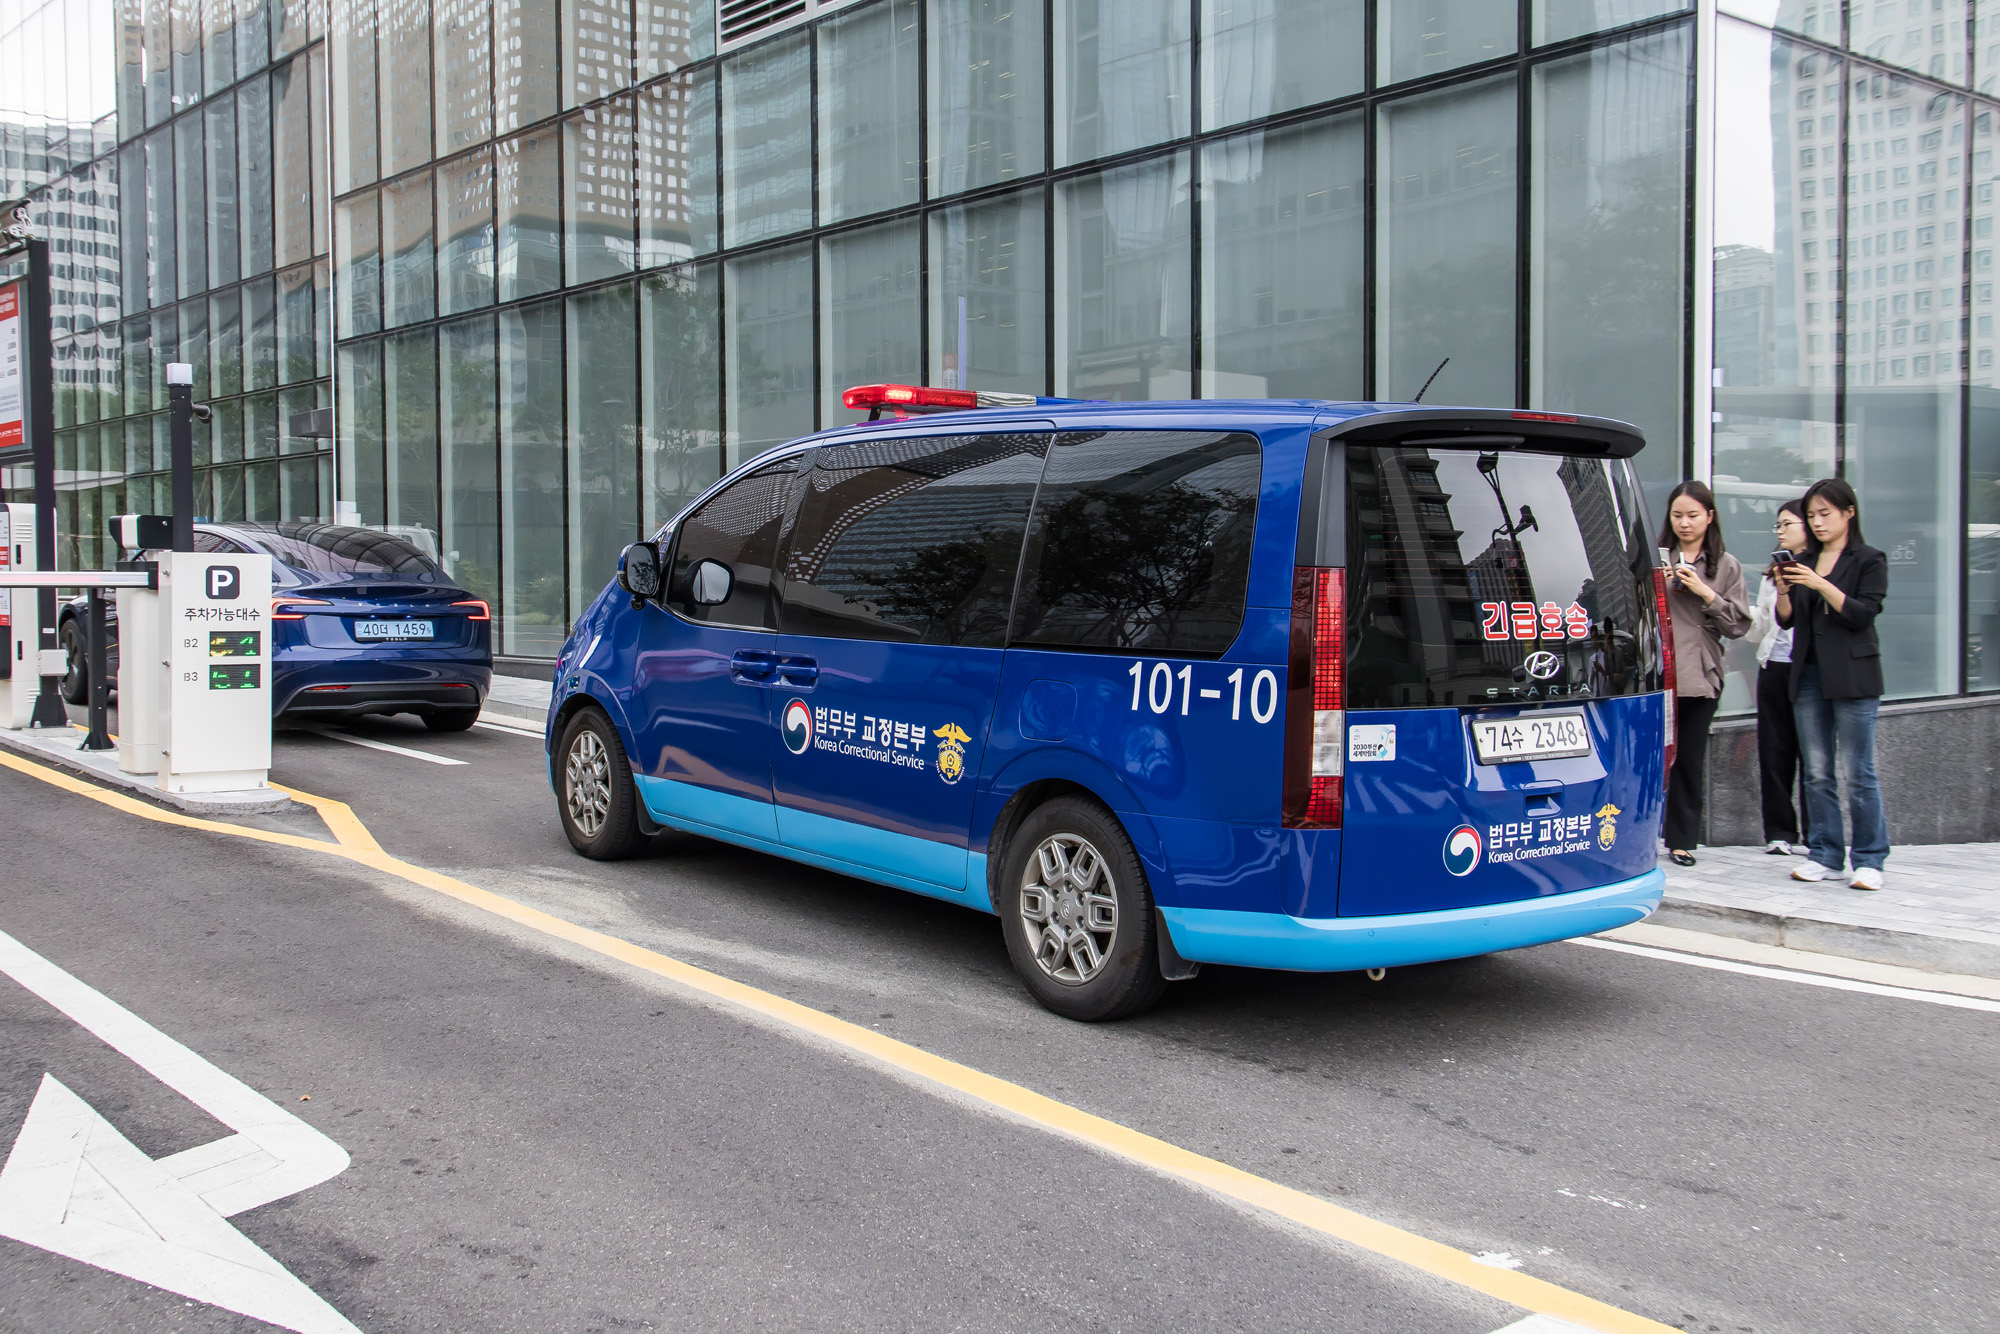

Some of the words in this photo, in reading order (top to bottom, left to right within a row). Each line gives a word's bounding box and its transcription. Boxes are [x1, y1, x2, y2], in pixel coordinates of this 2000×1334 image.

[211, 569, 234, 596] P
[184, 607, 261, 621] 주차가능대수
[1482, 601, 1589, 640] 긴급호송
[363, 623, 388, 635] 40더
[395, 623, 426, 635] 1459
[184, 638, 198, 648] B2
[184, 671, 199, 681] B3
[1128, 661, 1278, 724] 101-10
[1486, 683, 1591, 698] STARIA
[815, 706, 856, 739] 법무부
[862, 715, 926, 752] 교정본부
[1485, 725, 1525, 752] 74수
[1531, 720, 1578, 749] 2348
[814, 735, 837, 752] Korea
[838, 741, 890, 763] Correctional
[891, 750, 925, 770] Service
[1489, 821, 1533, 849] 법무부
[1538, 813, 1592, 842] 교정본부
[1488, 850, 1514, 864] Korea
[1514, 841, 1564, 860] Correctional
[1564, 839, 1591, 854] Service
